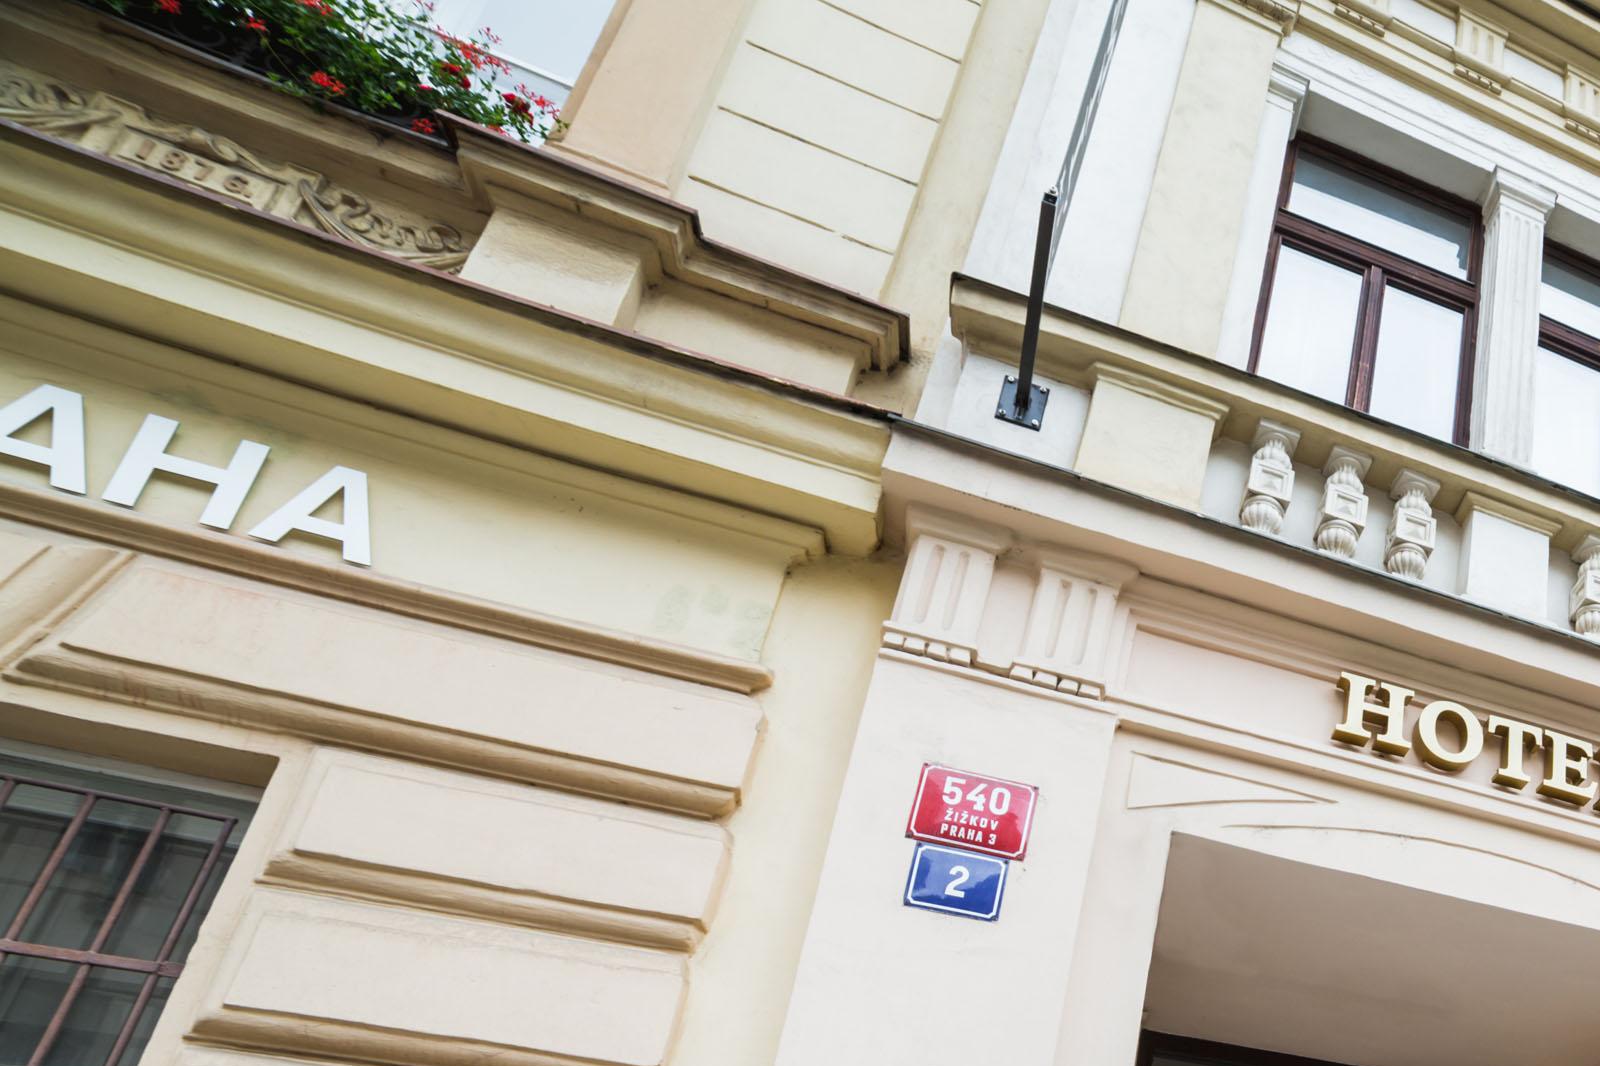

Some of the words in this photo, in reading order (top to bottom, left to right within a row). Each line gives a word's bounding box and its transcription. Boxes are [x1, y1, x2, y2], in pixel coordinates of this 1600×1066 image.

[0, 383, 371, 567] AHA
[942, 776, 1011, 815] 540
[940, 824, 982, 842] PRAHA
[988, 833, 997, 845] 3
[944, 808, 998, 830] ŽIŽKOV
[944, 866, 969, 898] 2
